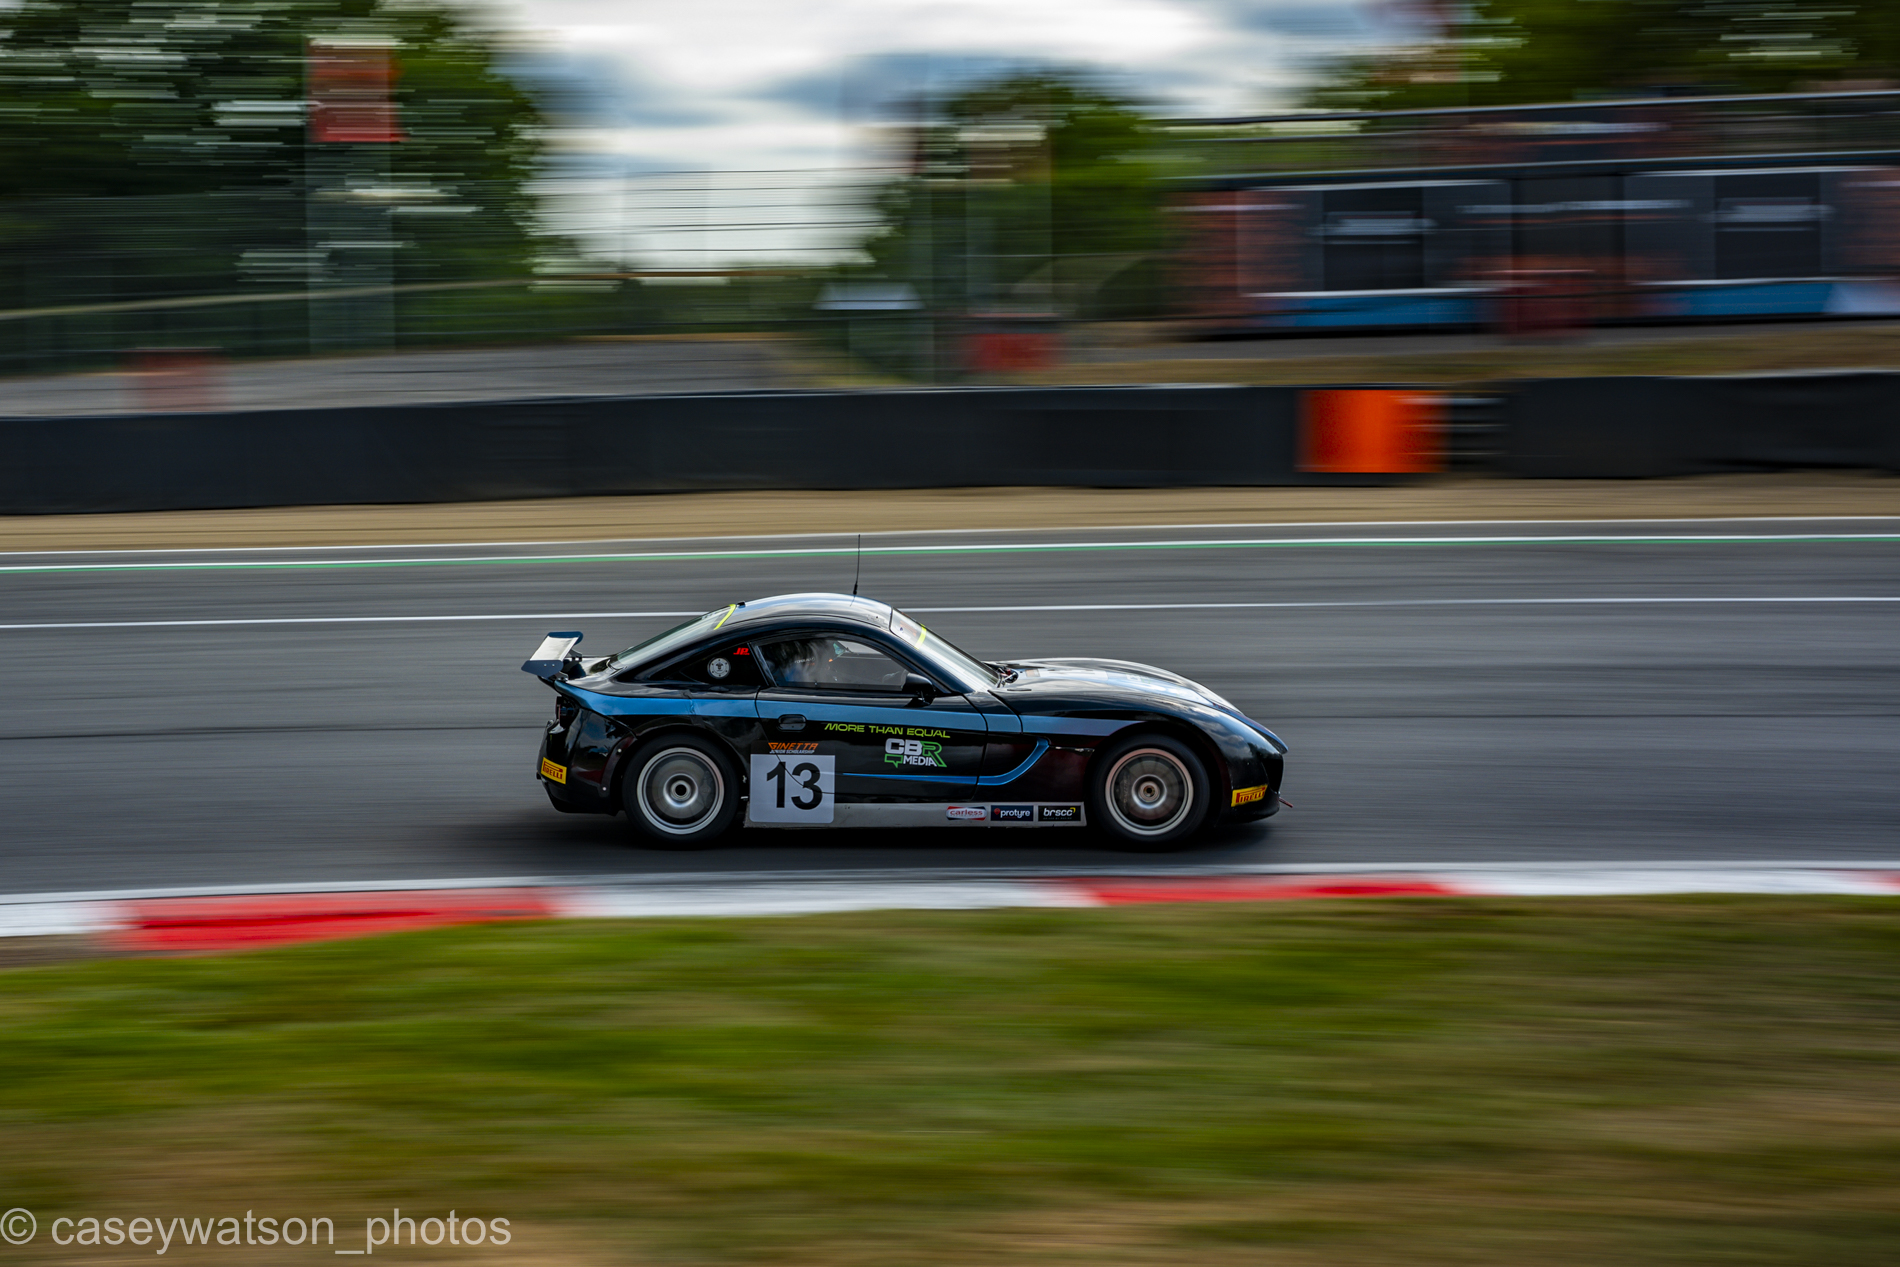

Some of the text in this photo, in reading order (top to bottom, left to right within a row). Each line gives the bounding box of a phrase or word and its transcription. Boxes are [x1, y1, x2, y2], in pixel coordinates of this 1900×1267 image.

[824, 723, 951, 738] MORE THAN EQUAL
[768, 742, 819, 750] GINETTA
[885, 738, 947, 767] CBR
[903, 755, 937, 767] MEDIA
[543, 760, 564, 780] PIRELLI
[766, 761, 823, 810] 13
[1236, 786, 1266, 803] PIRELLI
[949, 808, 983, 816] carless
[1000, 808, 1031, 818] protyre
[1043, 808, 1073, 816] brscc
